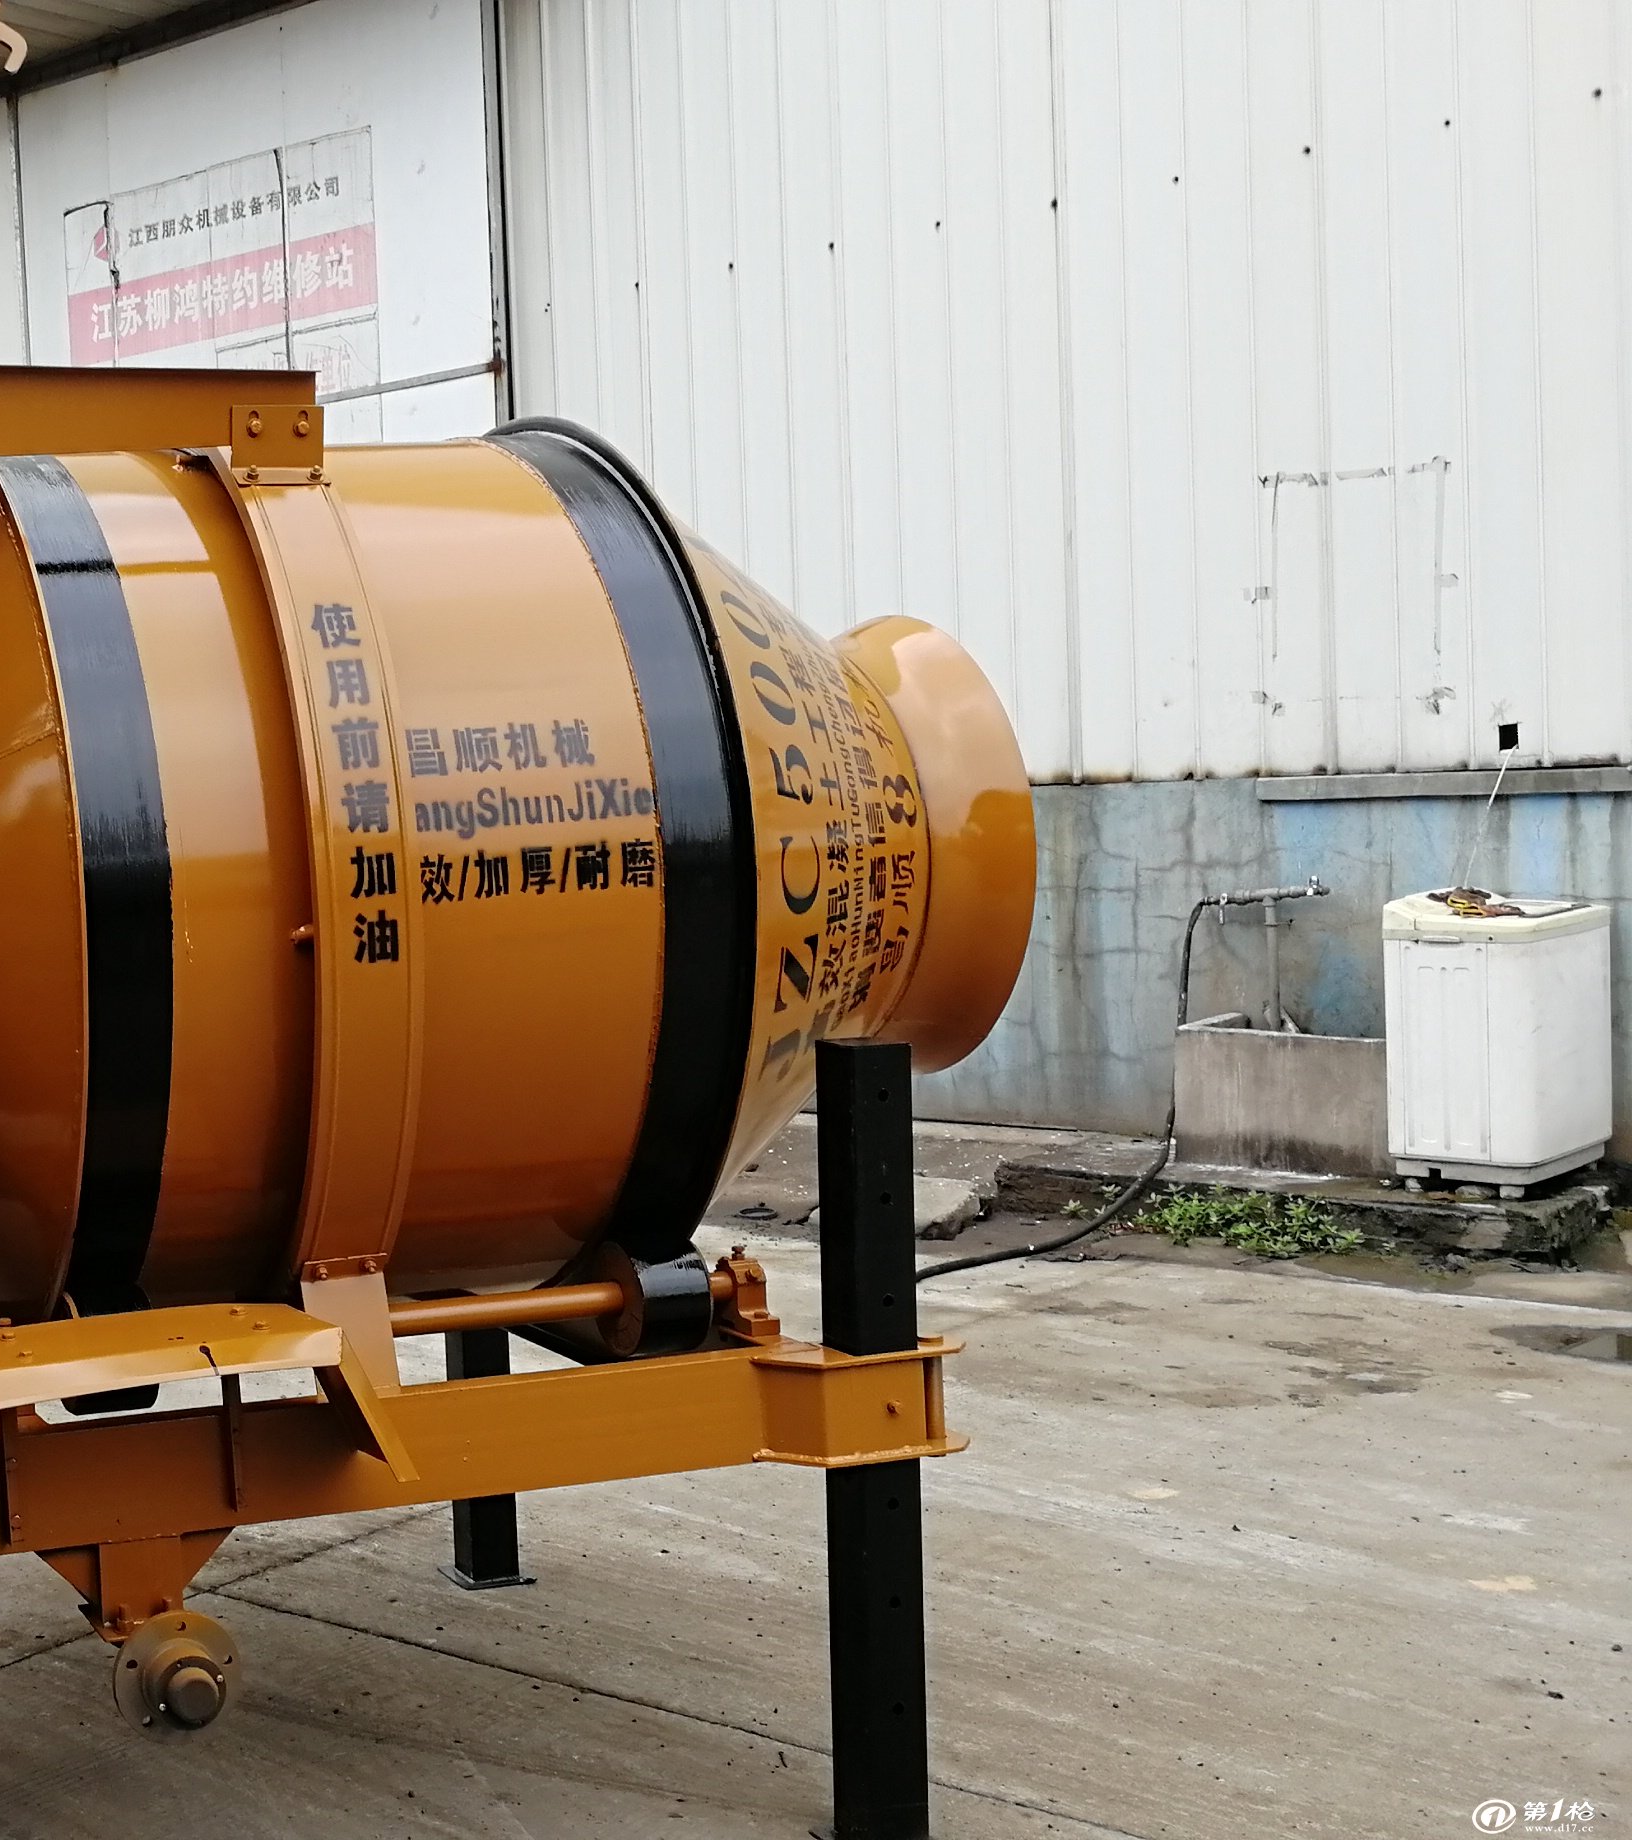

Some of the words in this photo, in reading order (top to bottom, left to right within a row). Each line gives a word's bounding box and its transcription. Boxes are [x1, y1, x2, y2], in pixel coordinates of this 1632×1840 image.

[311, 602, 400, 964] 使用前请加油
[405, 719, 597, 778] 昌顺机械
